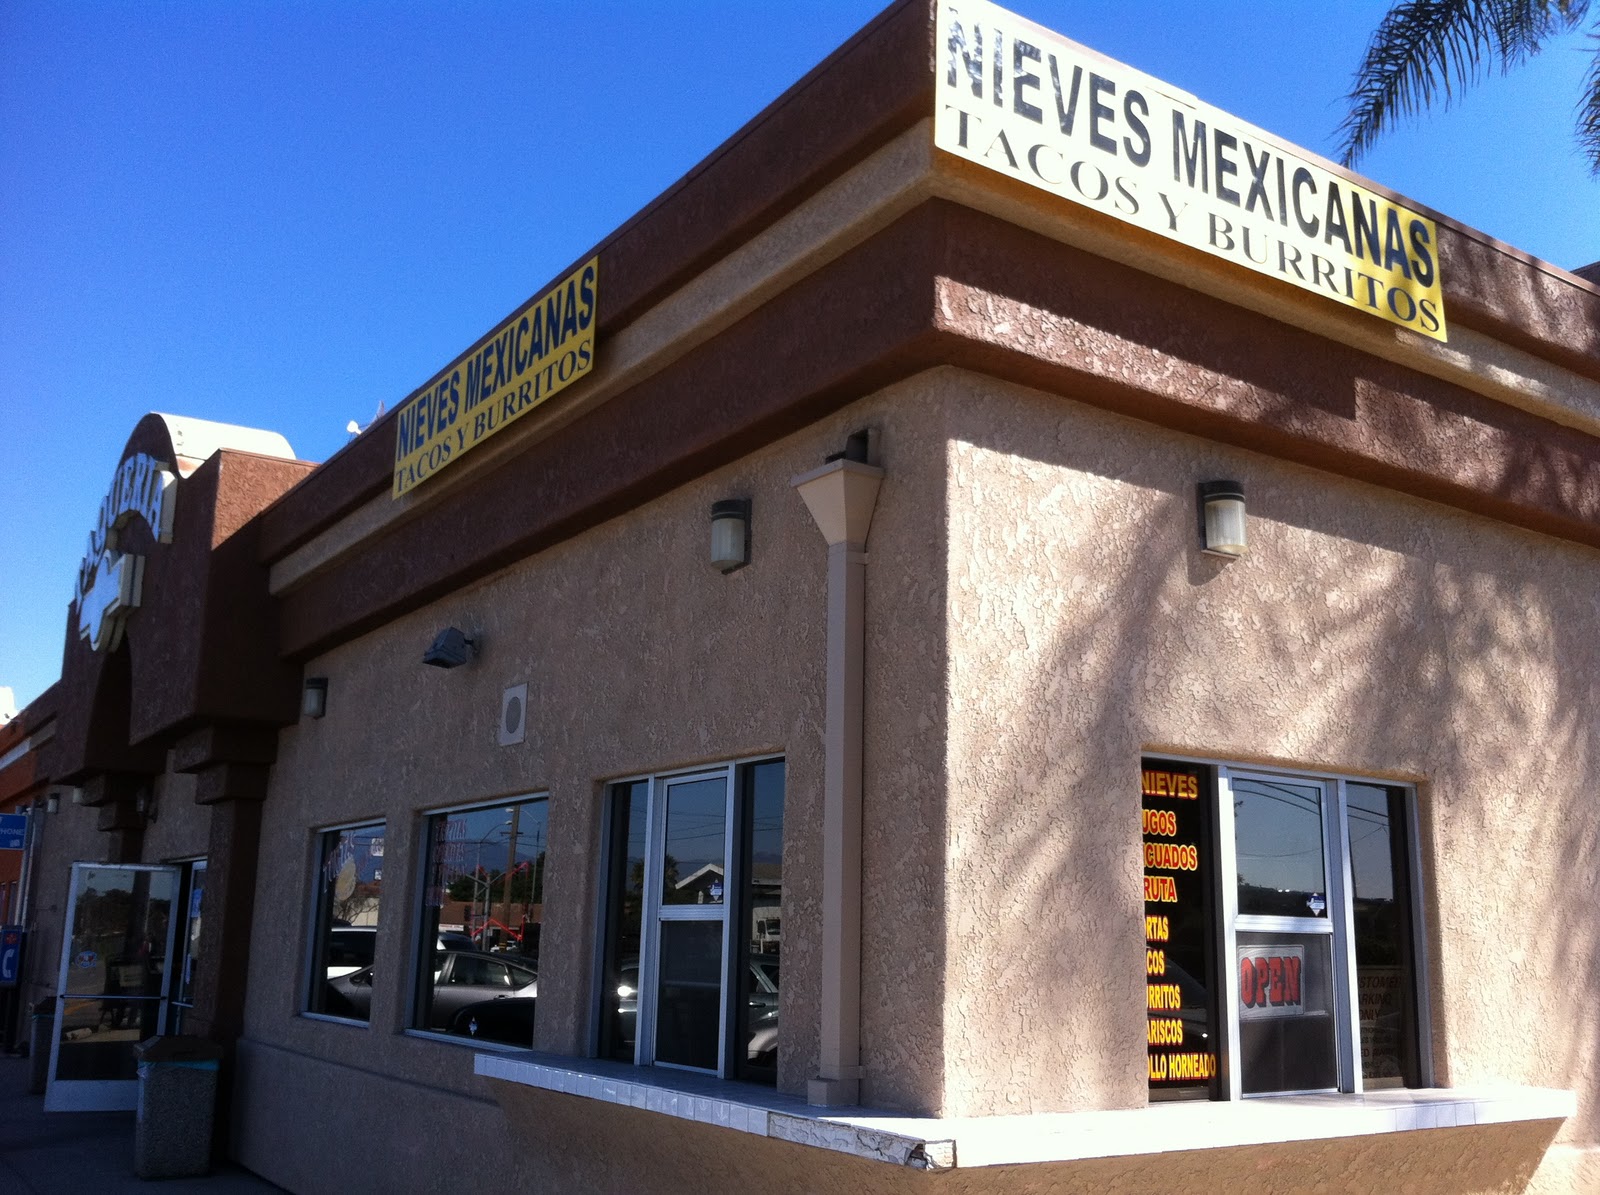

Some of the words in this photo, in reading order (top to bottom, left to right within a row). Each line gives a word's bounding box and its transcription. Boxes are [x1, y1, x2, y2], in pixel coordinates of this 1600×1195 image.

[947, 7, 1152, 168] NIEVES
[1173, 109, 1434, 289] MEXICANAS
[944, 104, 1139, 217] TACOS
[1159, 191, 1189, 233] Y
[1208, 211, 1441, 334] BURRITOS
[397, 370, 461, 462] NIEVES
[464, 266, 594, 414] MEXICANAS
[396, 437, 452, 492] TACOS
[456, 422, 469, 451] Y
[473, 339, 591, 442] BURRITOS
[1141, 771, 1198, 799] NIEVES
[1145, 915, 1169, 942] RTAS
[1146, 984, 1182, 1010] RRITOS
[1240, 956, 1302, 1008] OPEN
[1169, 1054, 1217, 1081] HORNEADO
